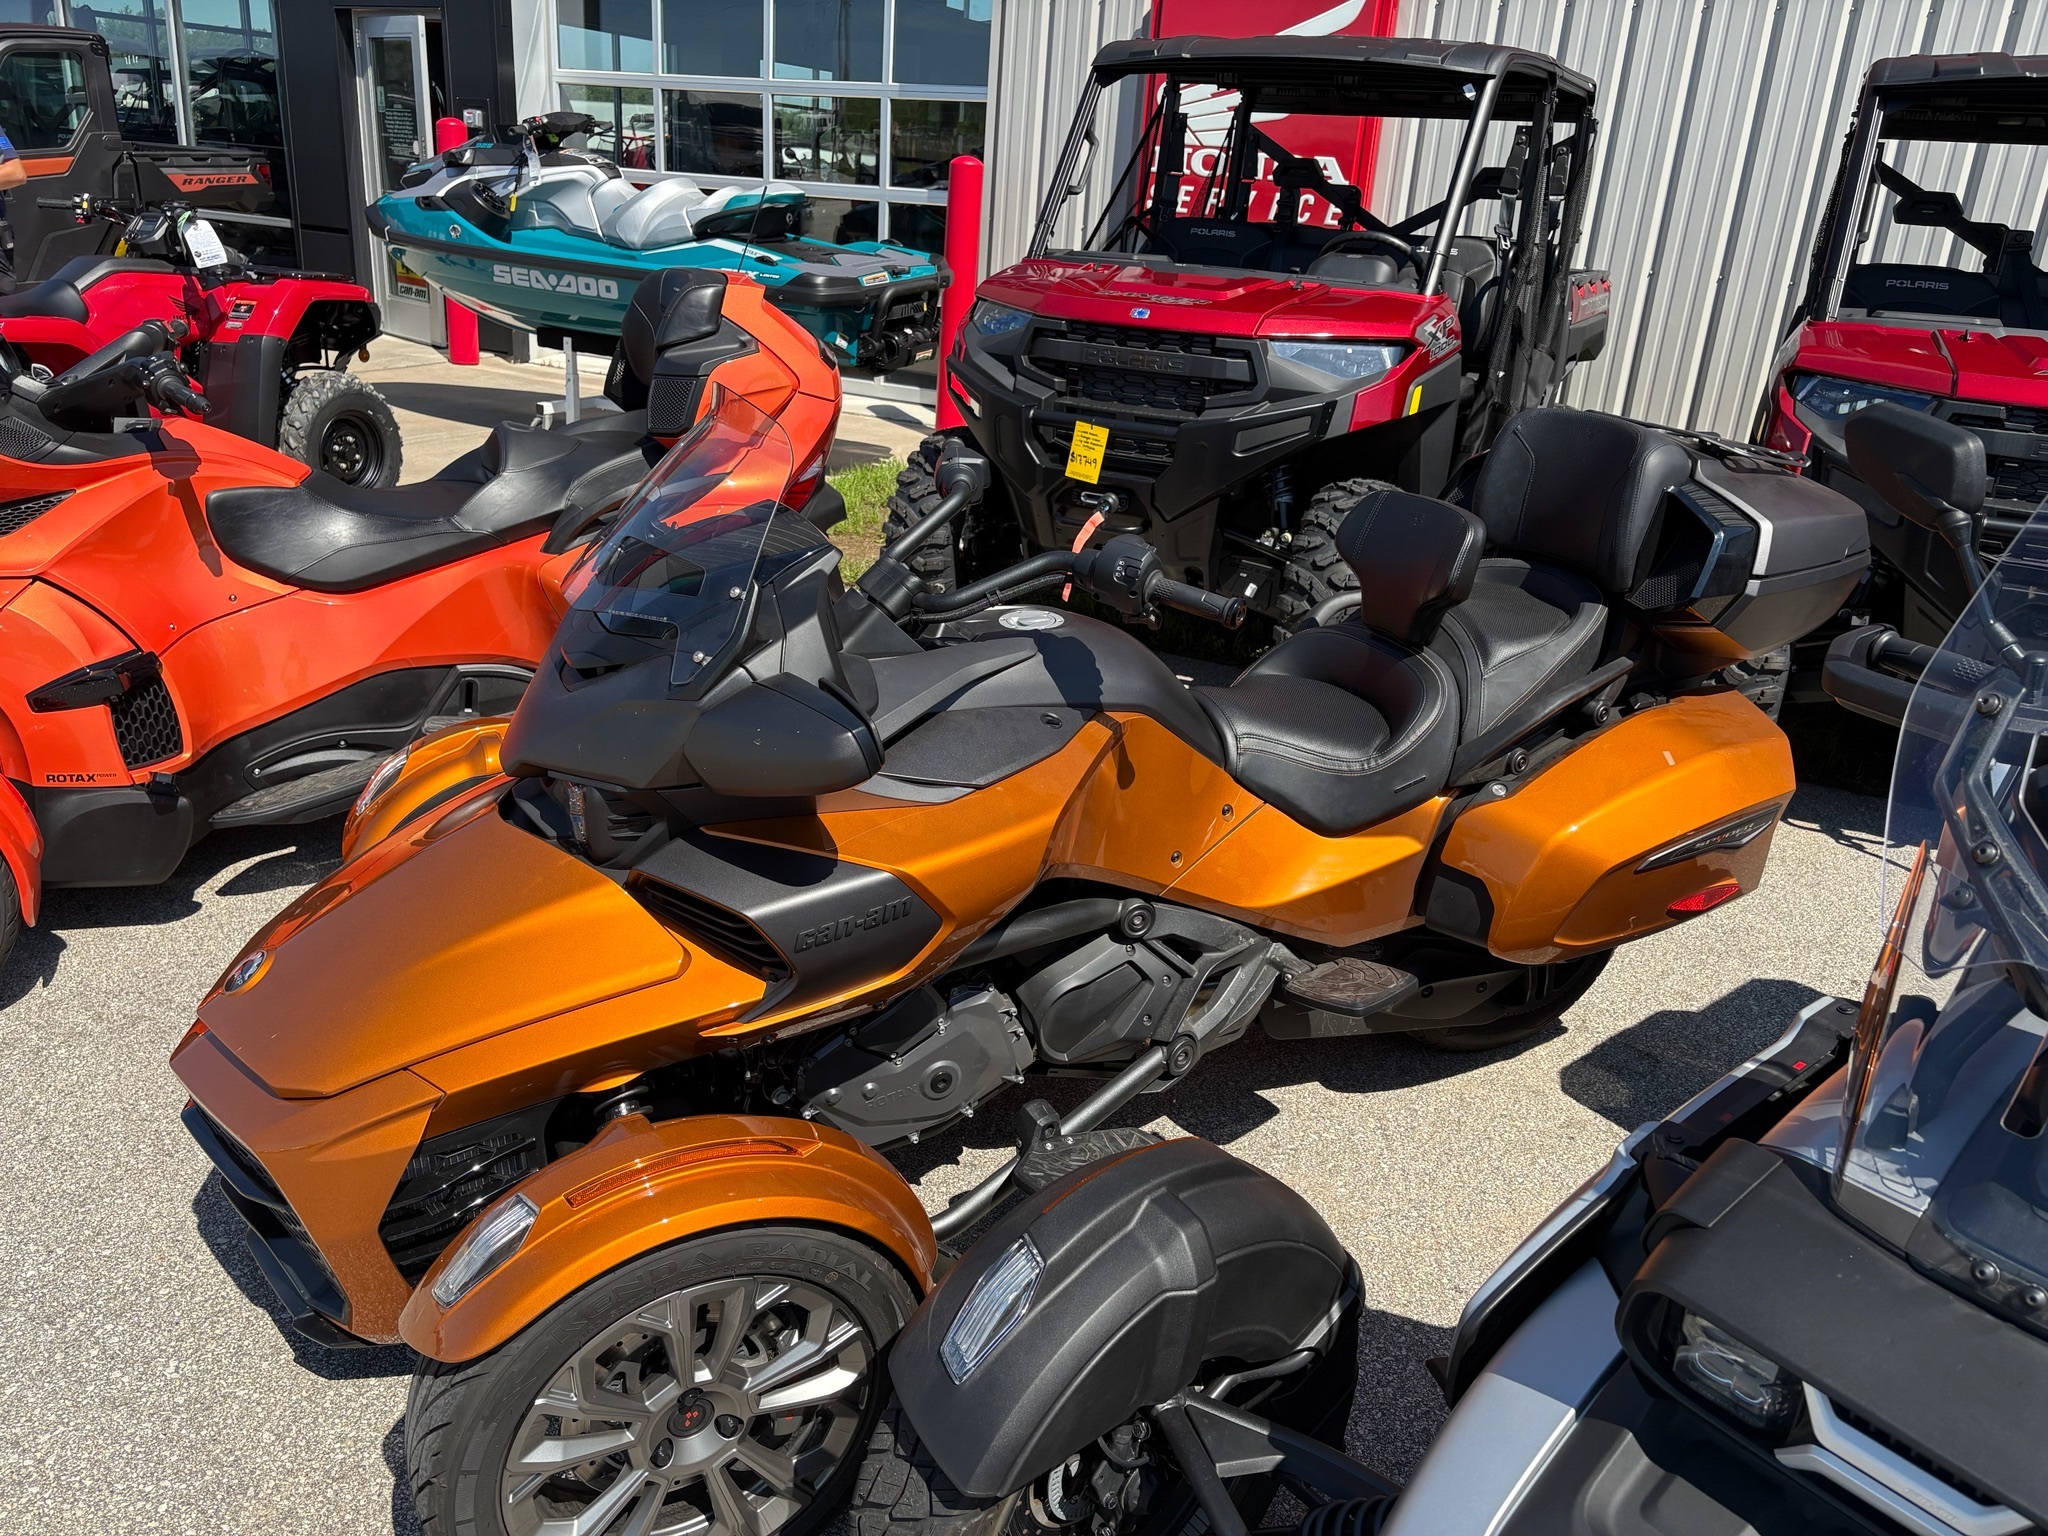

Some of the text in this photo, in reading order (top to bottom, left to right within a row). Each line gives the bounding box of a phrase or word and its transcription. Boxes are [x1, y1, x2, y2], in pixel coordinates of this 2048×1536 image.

[1151, 146, 1349, 185] HOA
[182, 176, 247, 186] RANGER
[1190, 227, 1236, 238] POLARIS
[400, 285, 427, 299] can-am
[1885, 279, 1949, 290] POLARIS
[1421, 314, 1456, 354] XP
[1429, 334, 1457, 359] 1000
[1084, 346, 1184, 372] POLARIS
[45, 773, 97, 783] ROTAX
[794, 895, 913, 955] can-am
[551, 1252, 720, 1344] KENDA
[743, 1242, 873, 1293] RADIAL
